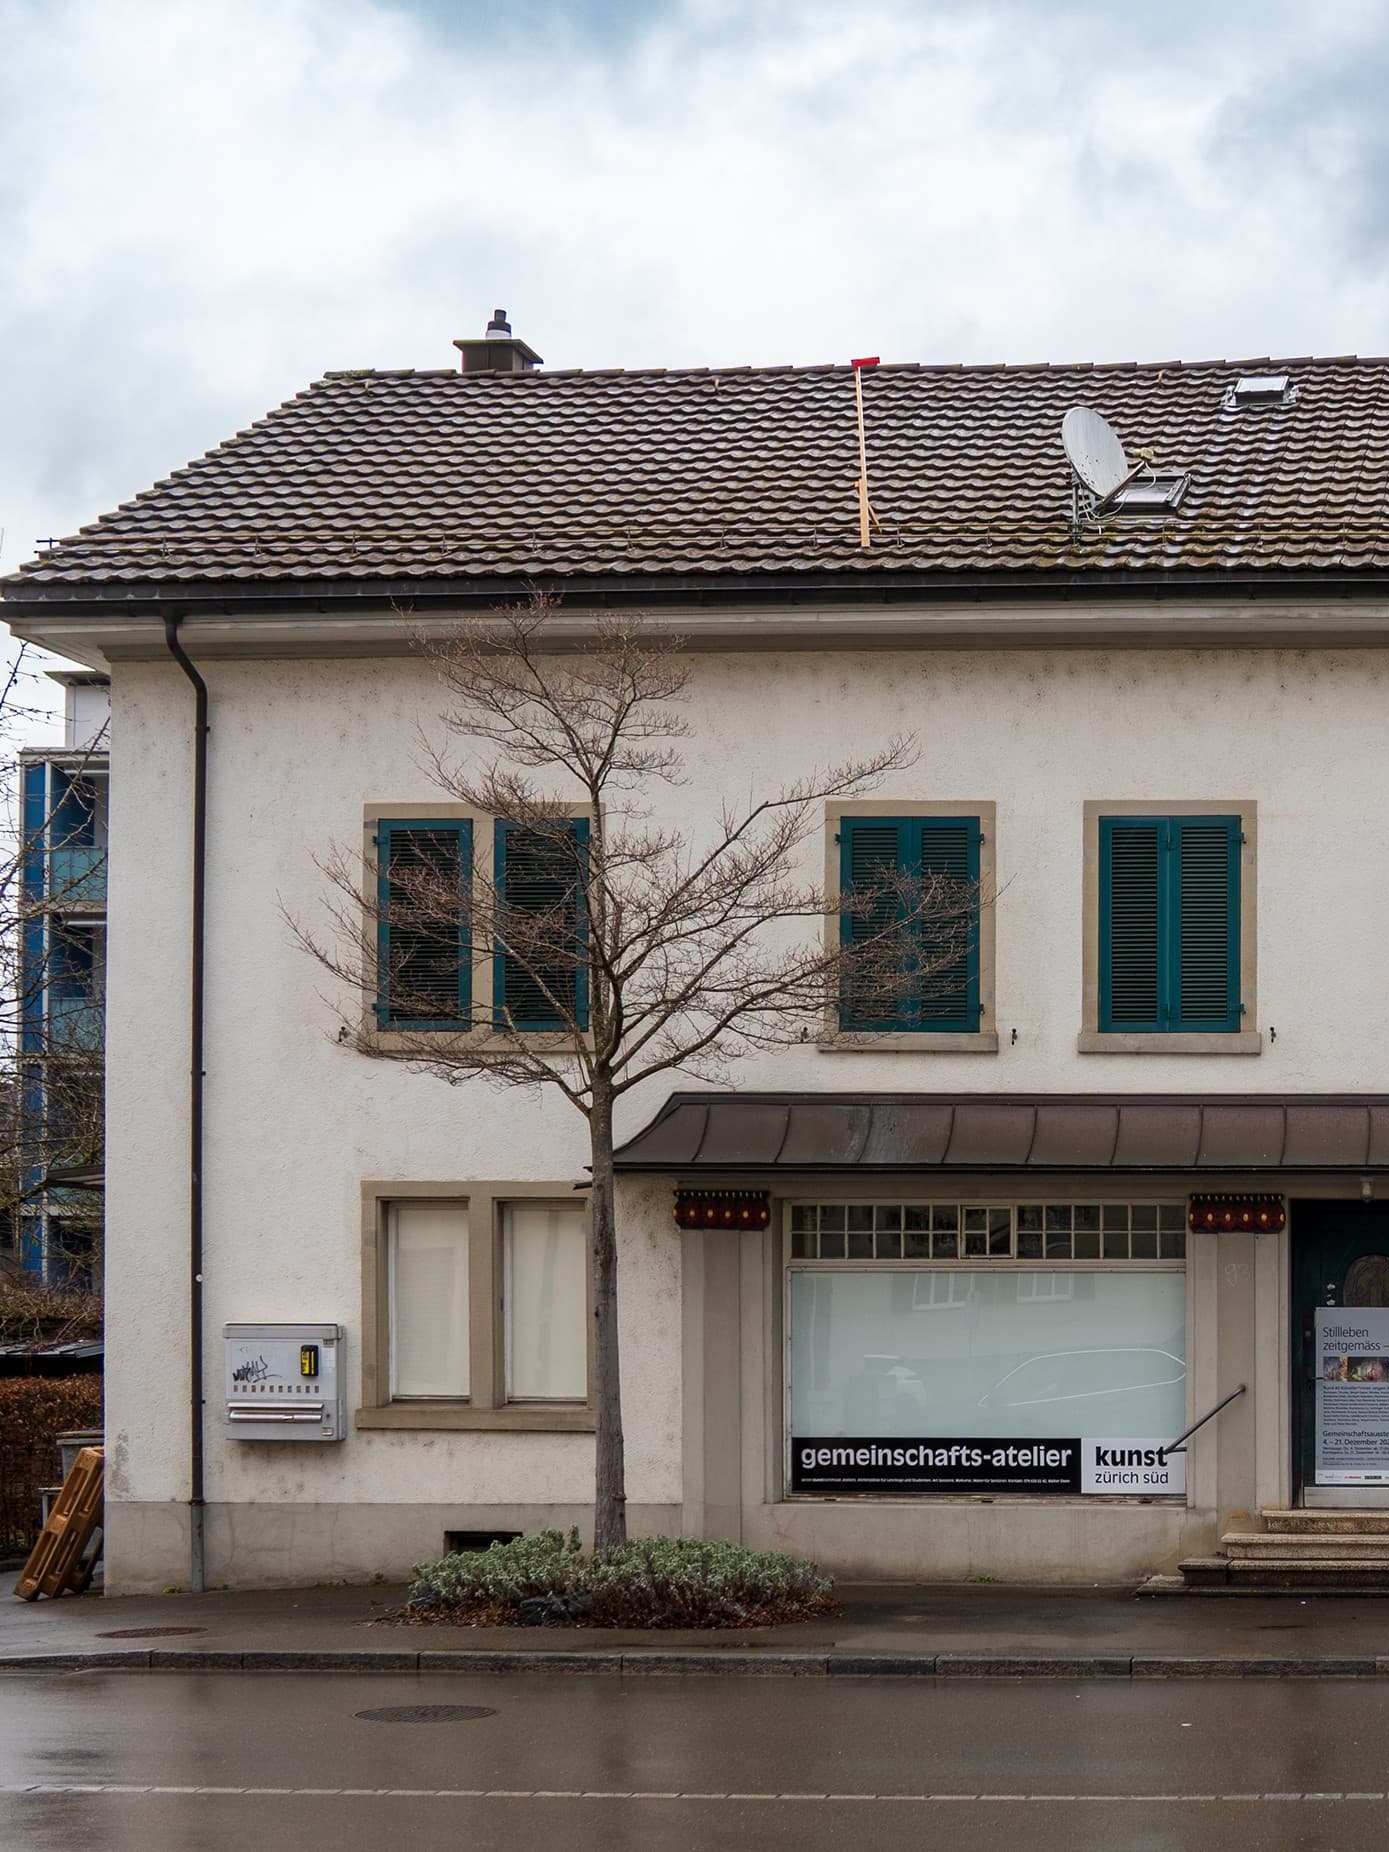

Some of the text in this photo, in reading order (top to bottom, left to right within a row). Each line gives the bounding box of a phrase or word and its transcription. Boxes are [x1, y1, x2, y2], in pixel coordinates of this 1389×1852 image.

[1322, 1326, 1369, 1338] Stillleben
[1322, 1340, 1381, 1354] zeitgemäss
[1344, 1438, 1378, 1446] Dezember
[801, 1445, 1072, 1469] gemeinschafts-atelier
[1095, 1446, 1168, 1467] kunst
[1095, 1471, 1169, 1485] zürich süd
